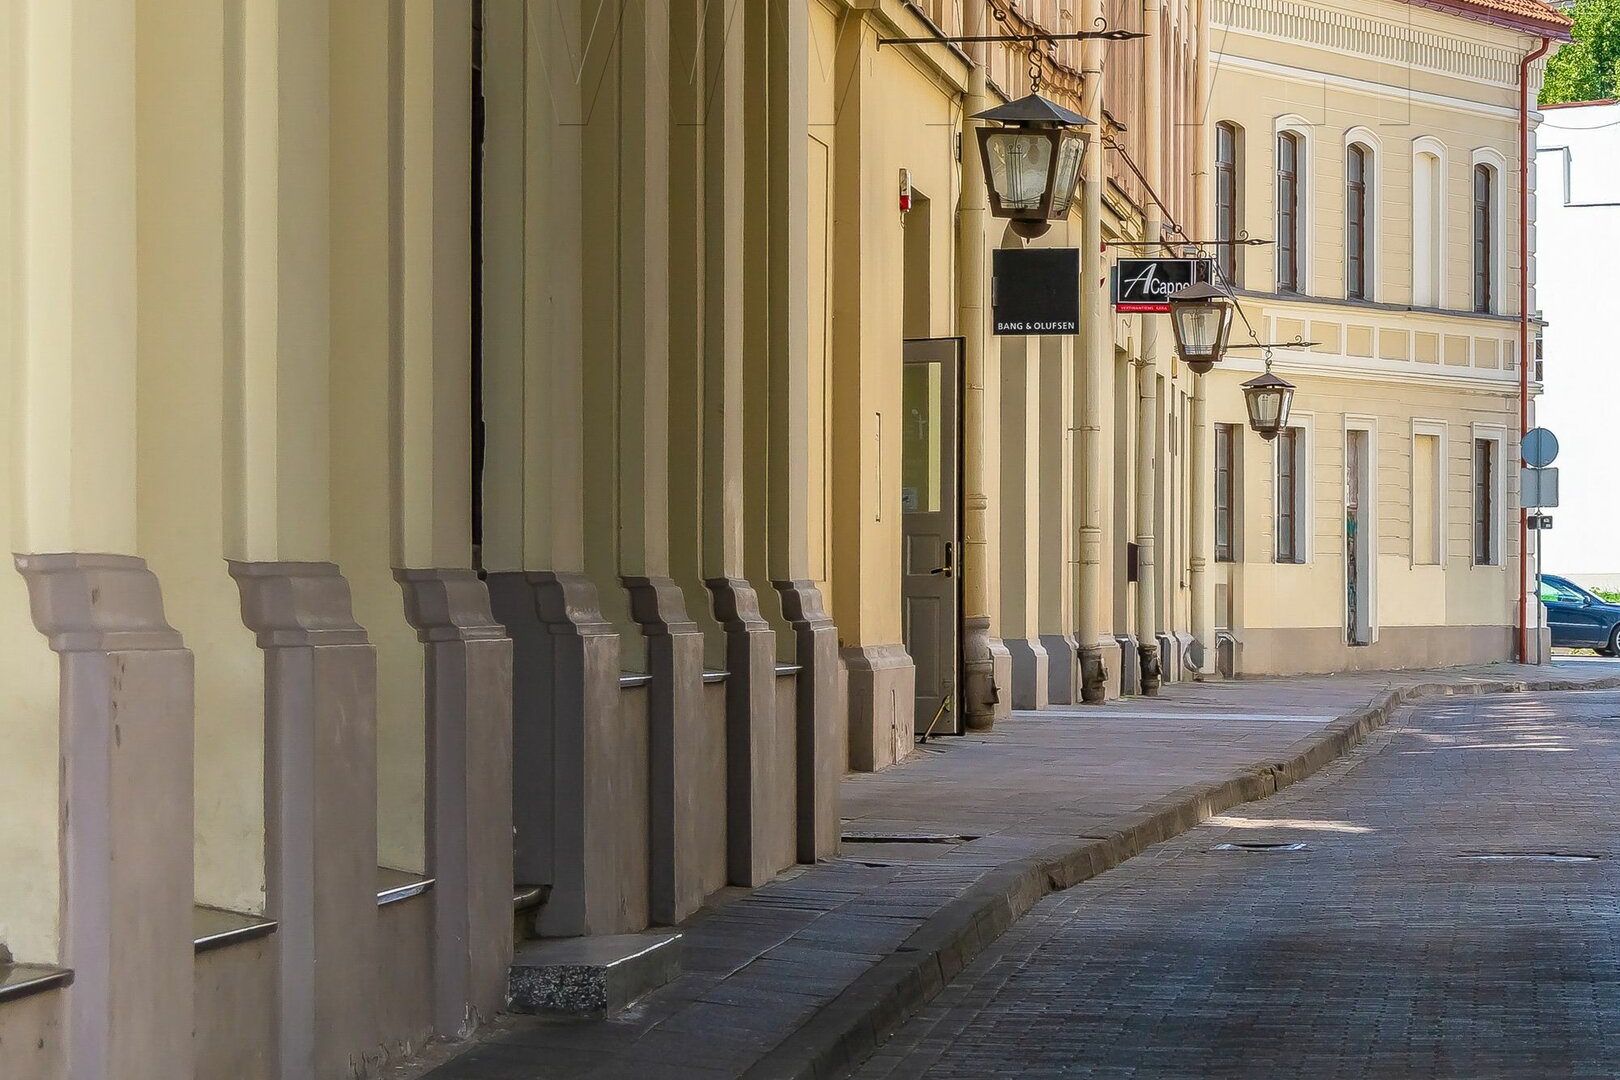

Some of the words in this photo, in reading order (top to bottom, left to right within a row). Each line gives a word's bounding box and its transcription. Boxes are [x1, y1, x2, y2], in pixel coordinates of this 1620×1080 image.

[997, 322, 1023, 330] BANG
[1025, 322, 1032, 330] &
[1033, 322, 1075, 330] OLUFSEN
